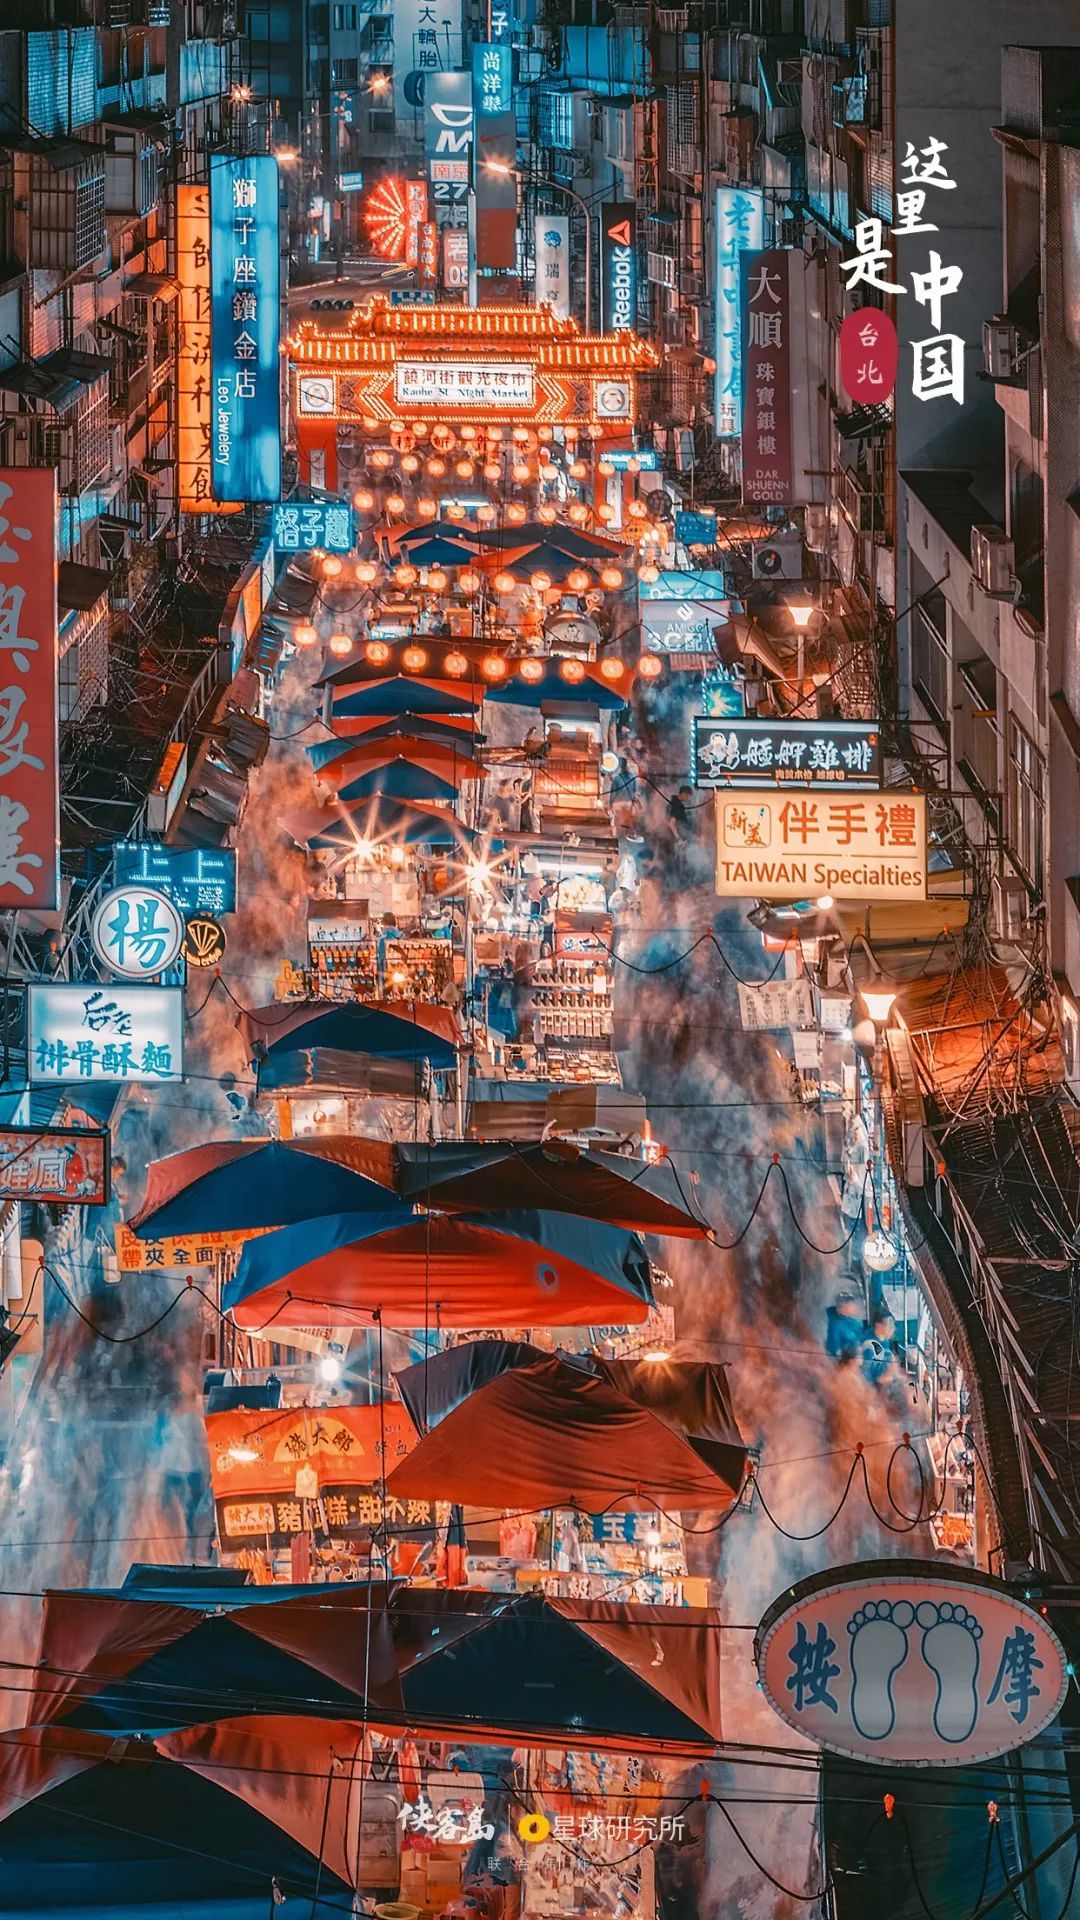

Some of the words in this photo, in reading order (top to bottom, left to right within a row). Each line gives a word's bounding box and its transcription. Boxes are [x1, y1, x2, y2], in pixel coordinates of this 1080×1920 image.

[232, 178, 257, 398] 獅子座鑽金店
[612, 246, 631, 328] Reebok
[748, 266, 782, 349] 大順
[217, 378, 231, 404] Leo
[402, 387, 432, 397] Raohe
[492, 389, 529, 398] Market
[756, 362, 777, 456] 珠寶銀樓
[746, 480, 789, 491] SHUENN
[756, 469, 779, 480] DAR
[752, 490, 784, 501] GOLD
[779, 800, 917, 847] 伴手禮
[721, 861, 807, 884] TAIWAN
[814, 863, 922, 889] Specialties
[108, 899, 170, 969] 楊
[36, 1038, 174, 1078] 排骨酥麵
